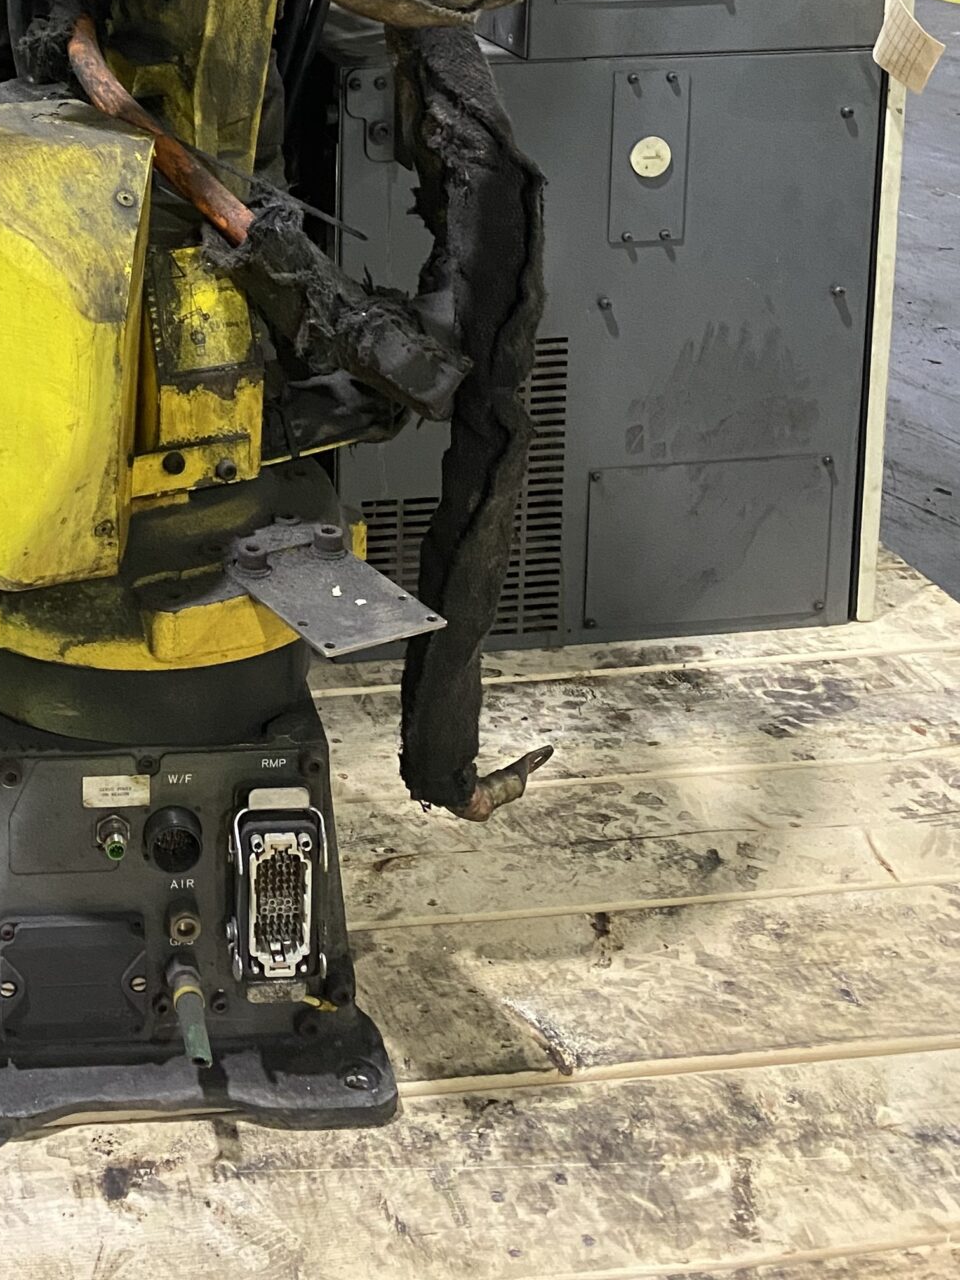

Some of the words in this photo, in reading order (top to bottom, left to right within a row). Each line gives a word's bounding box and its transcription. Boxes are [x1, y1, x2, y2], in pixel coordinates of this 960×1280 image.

[261, 758, 287, 768] RMP
[167, 773, 193, 784] W/F
[170, 879, 195, 889] AIR
